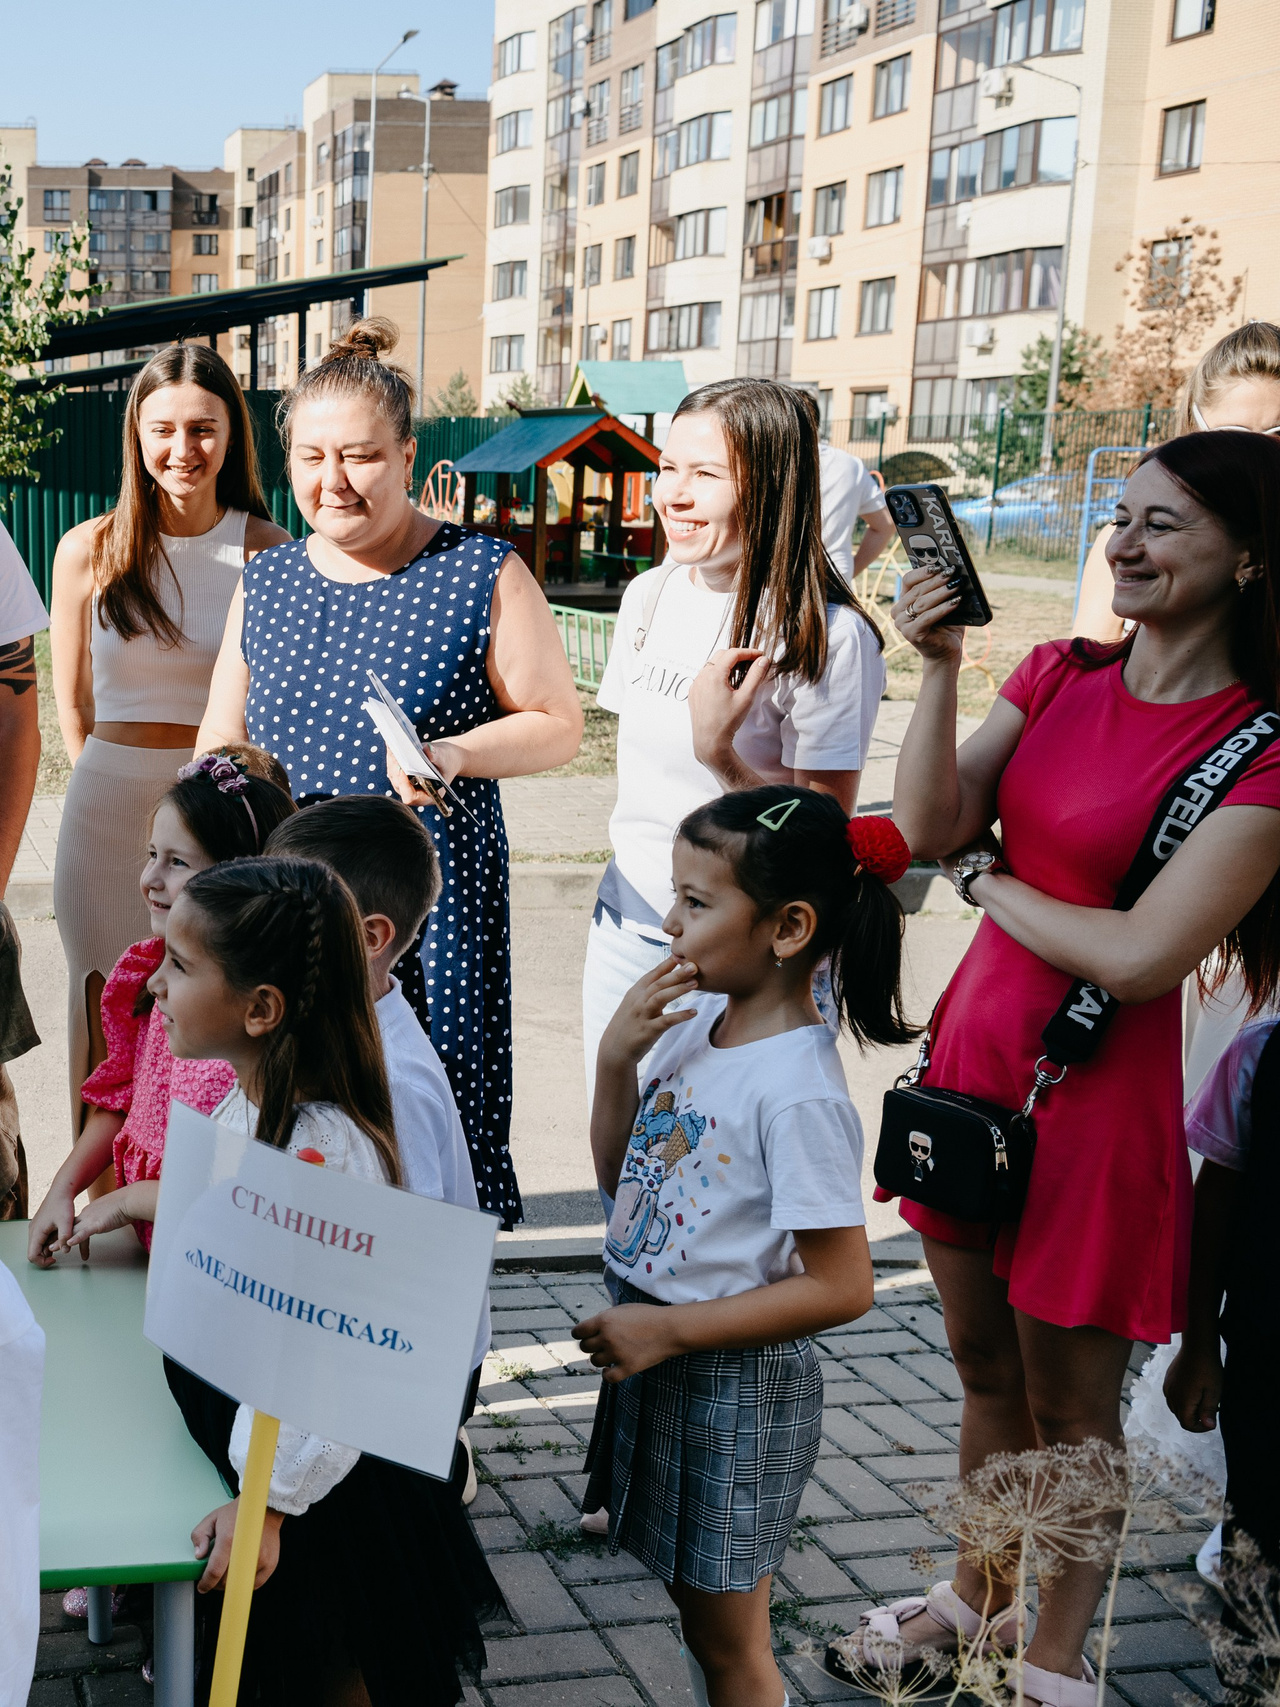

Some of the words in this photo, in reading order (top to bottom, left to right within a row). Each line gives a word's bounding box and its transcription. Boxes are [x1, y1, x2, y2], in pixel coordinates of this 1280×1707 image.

[921, 496, 955, 558] KARL
[1152, 711, 1280, 861] LAGERFELD
[231, 1184, 376, 1258] СТАНЦИЯ
[184, 1247, 414, 1355] «МЕДИЦИНСКАЯ»
